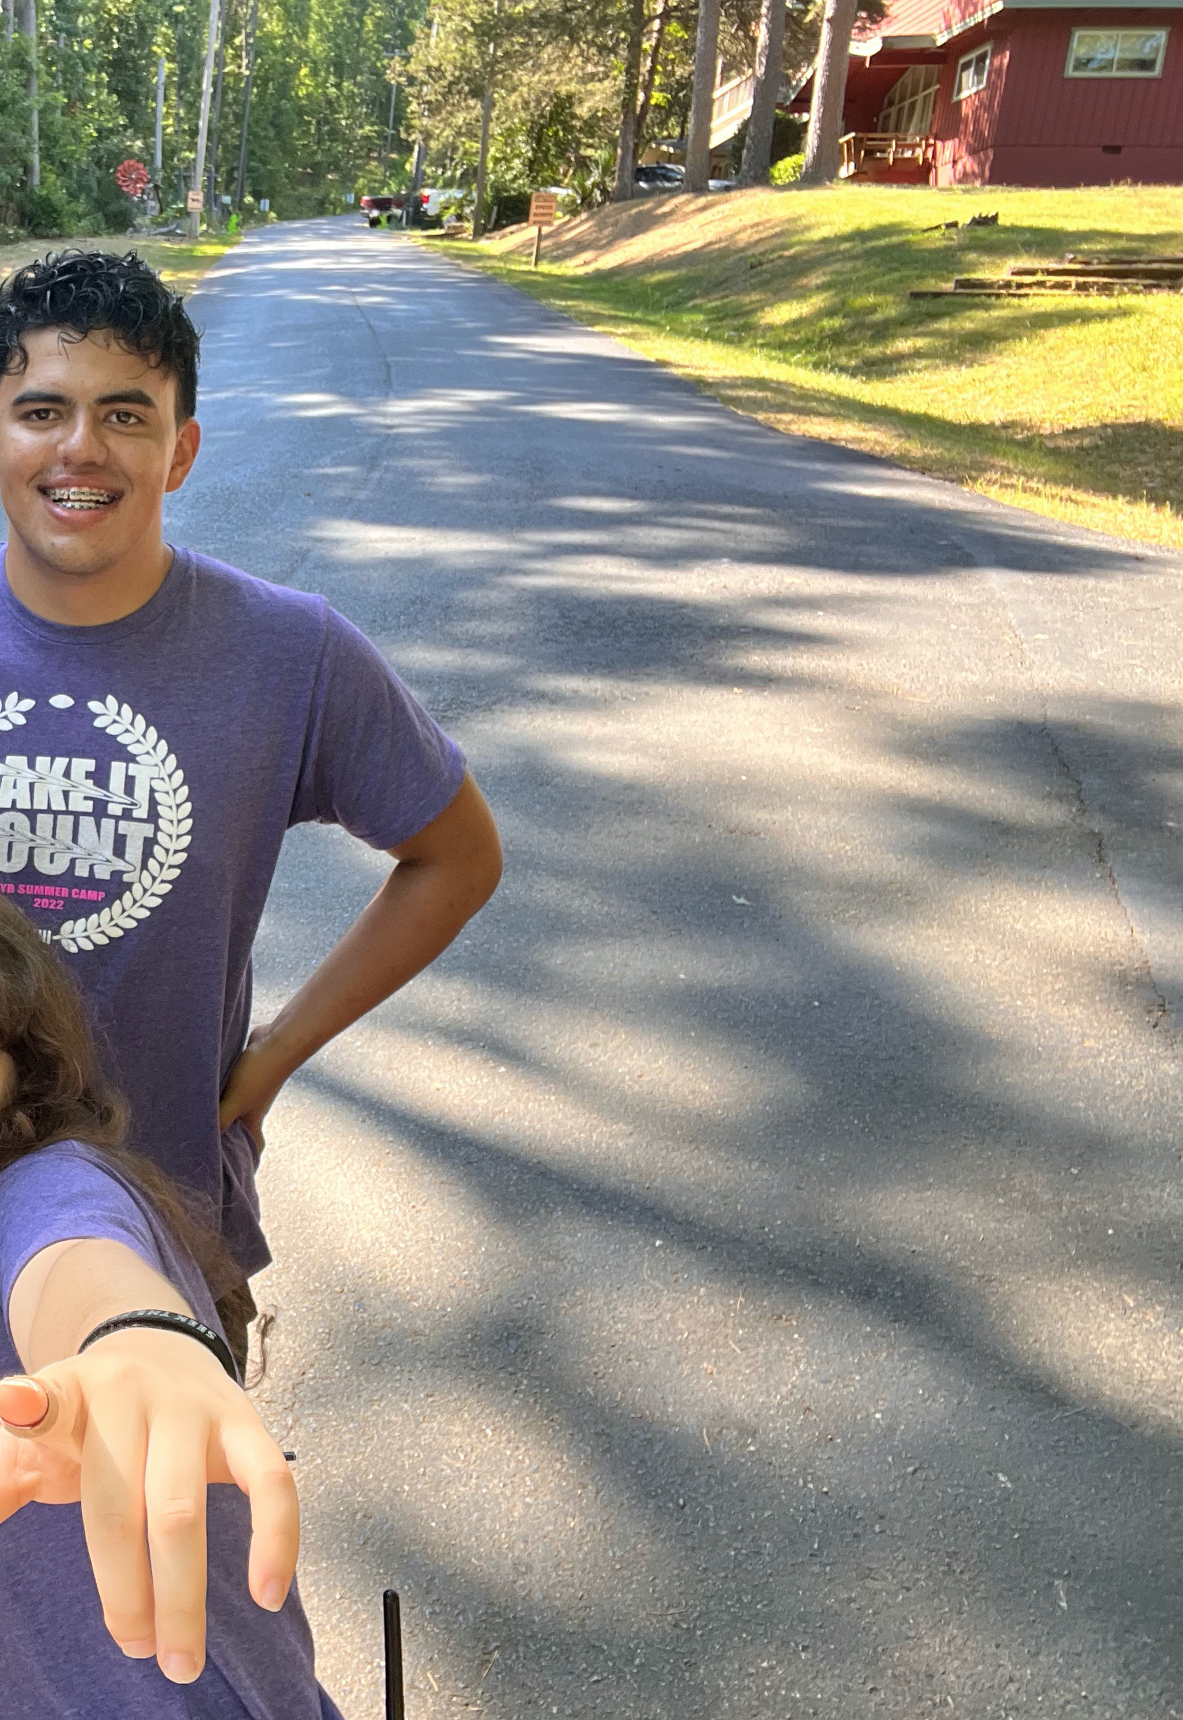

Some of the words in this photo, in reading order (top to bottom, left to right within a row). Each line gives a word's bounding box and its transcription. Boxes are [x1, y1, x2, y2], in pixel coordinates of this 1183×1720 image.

[107, 761, 161, 819] IT
[17, 883, 70, 898] SUMMER
[71, 889, 106, 902] CAMP
[33, 898, 65, 910] 2022
